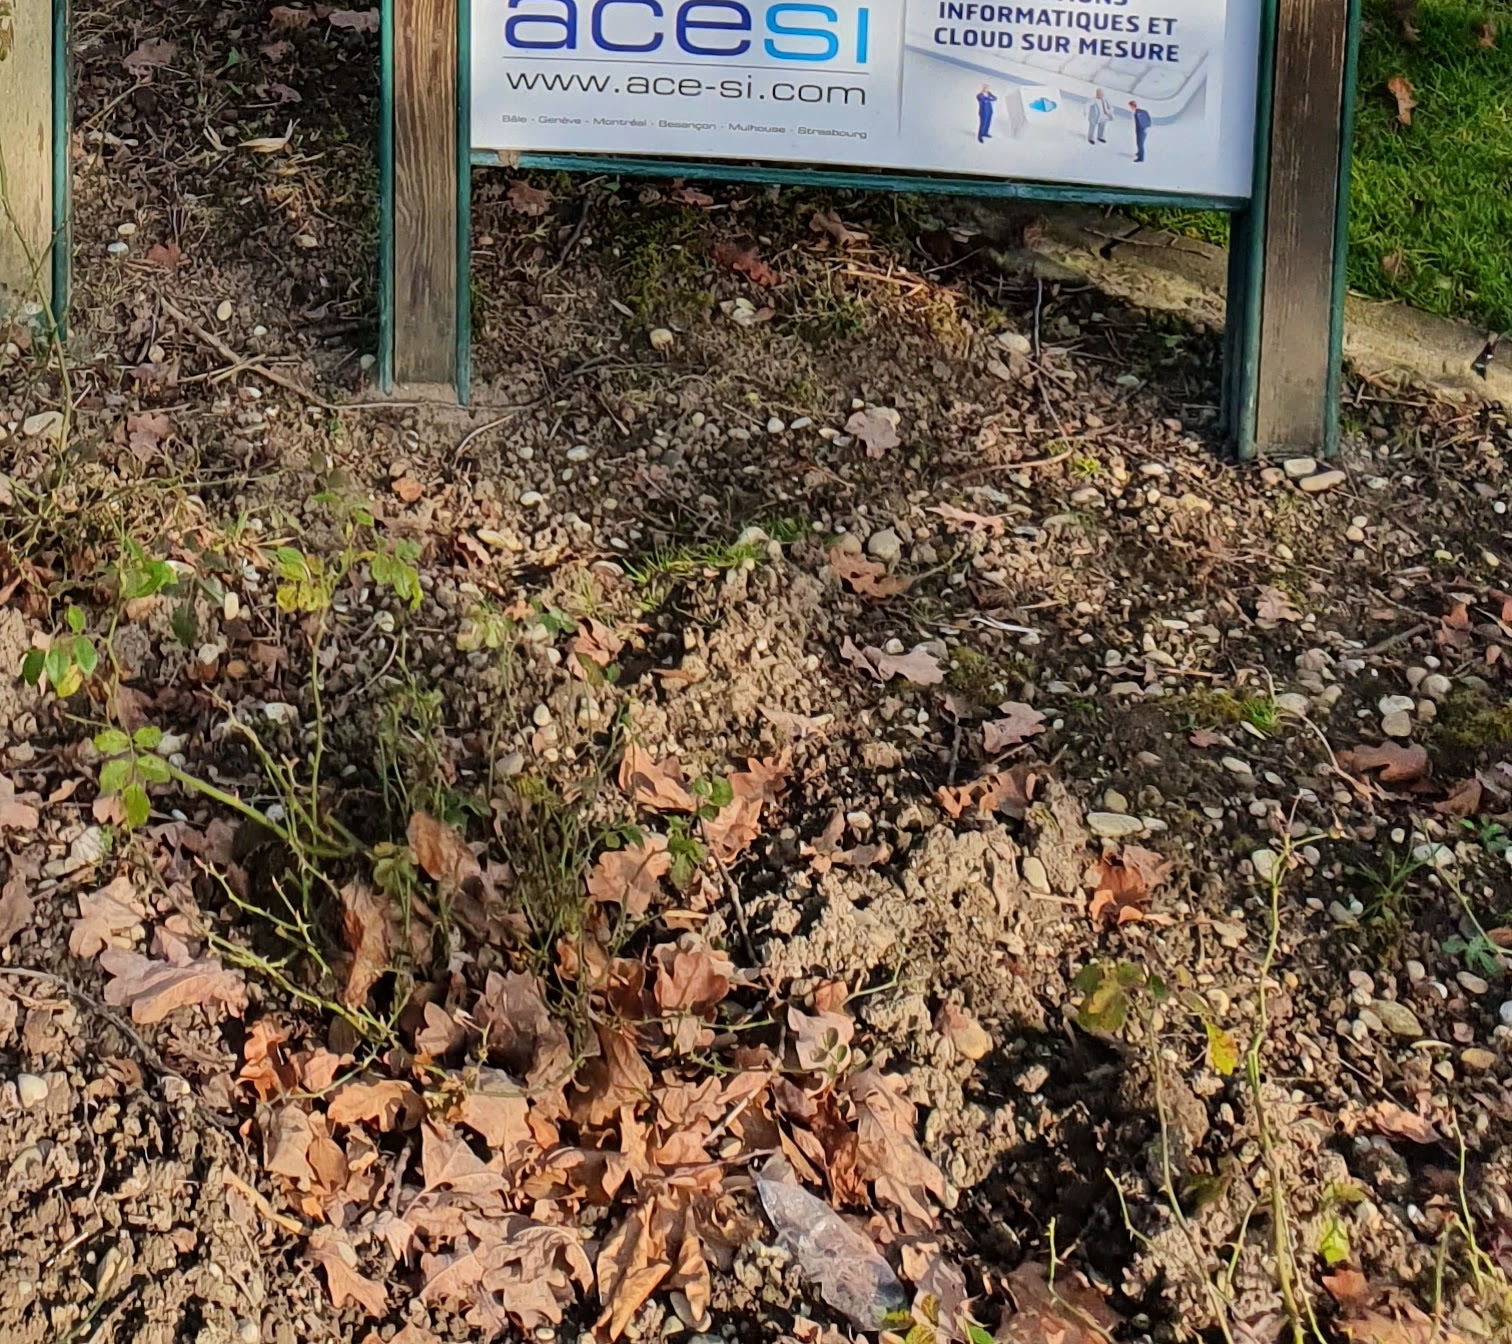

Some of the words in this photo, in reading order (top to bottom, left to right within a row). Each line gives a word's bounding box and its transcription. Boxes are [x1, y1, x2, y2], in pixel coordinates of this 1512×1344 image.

[939, 2, 1139, 32] INFORMATIQUES
[1148, 17, 1177, 35] ET
[934, 28, 1013, 48] CLOUD
[1021, 33, 1070, 54] SUR
[1079, 38, 1179, 62] MESURE
[506, 73, 866, 105] www.ace-si.com
[502, 115, 527, 123] Bâle
[539, 116, 581, 124] Genève
[594, 118, 646, 126] Montréal
[659, 120, 716, 130] Besançon
[729, 123, 785, 133] Mulhouse
[798, 127, 867, 139] Strasbourg
